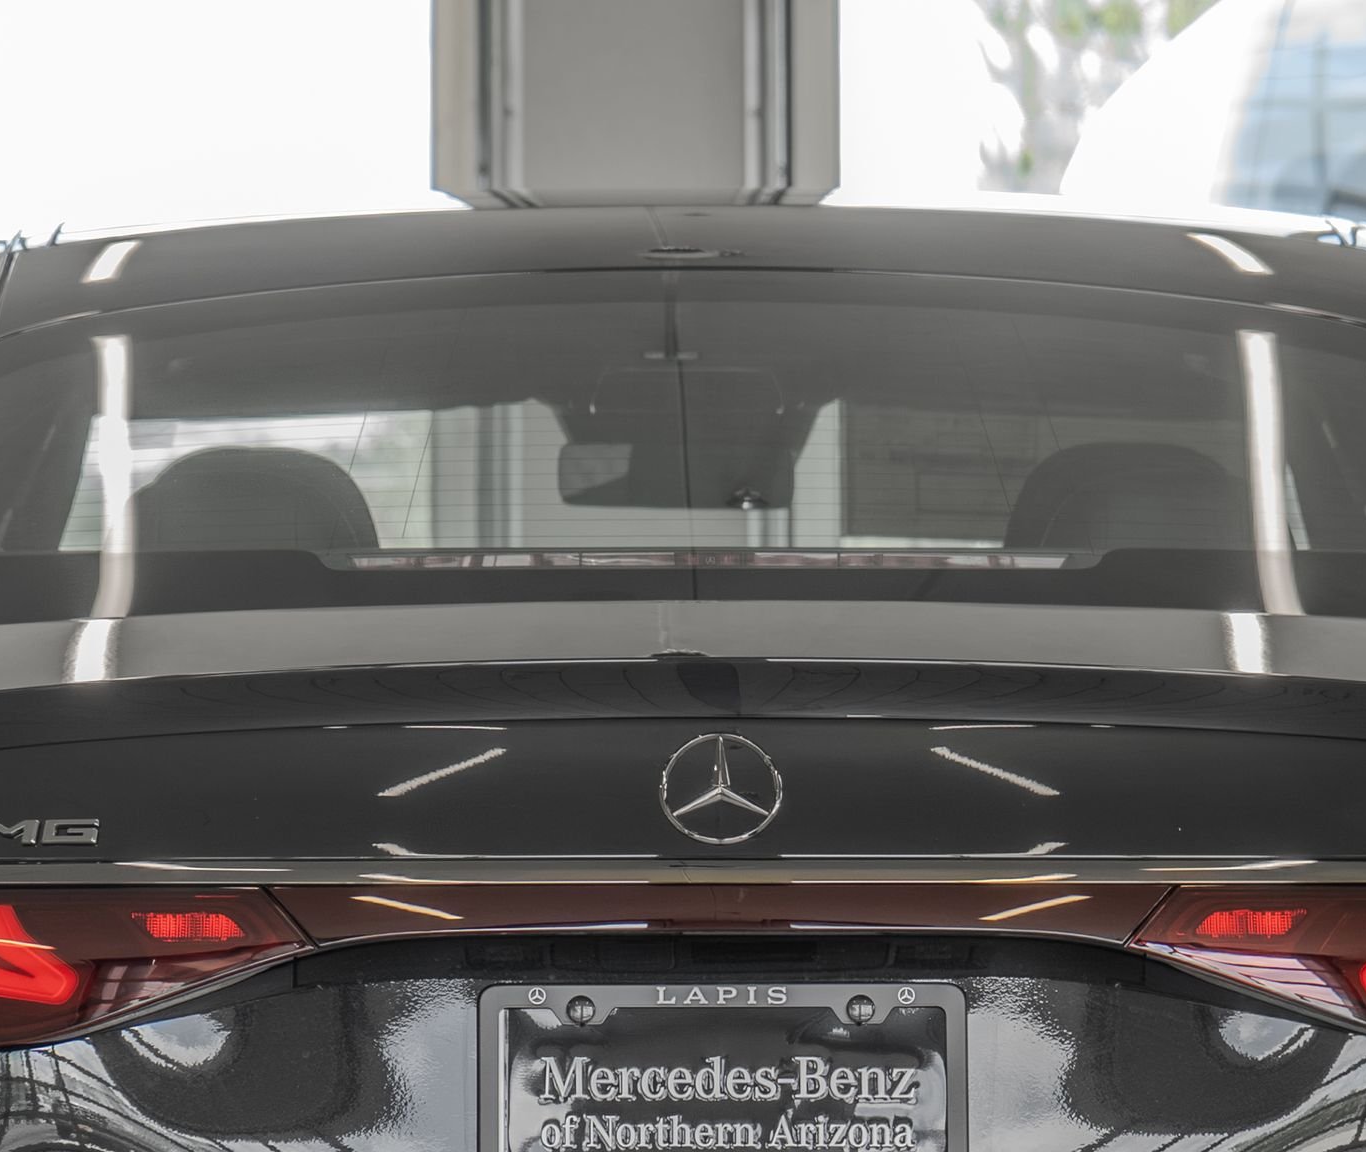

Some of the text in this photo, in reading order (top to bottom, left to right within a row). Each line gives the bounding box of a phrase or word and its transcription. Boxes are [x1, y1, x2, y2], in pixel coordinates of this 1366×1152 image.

[656, 986, 788, 1005] LAPIS
[539, 1056, 917, 1102] Mercedes-Benz
[540, 1114, 916, 1150] of Northern Arizona
